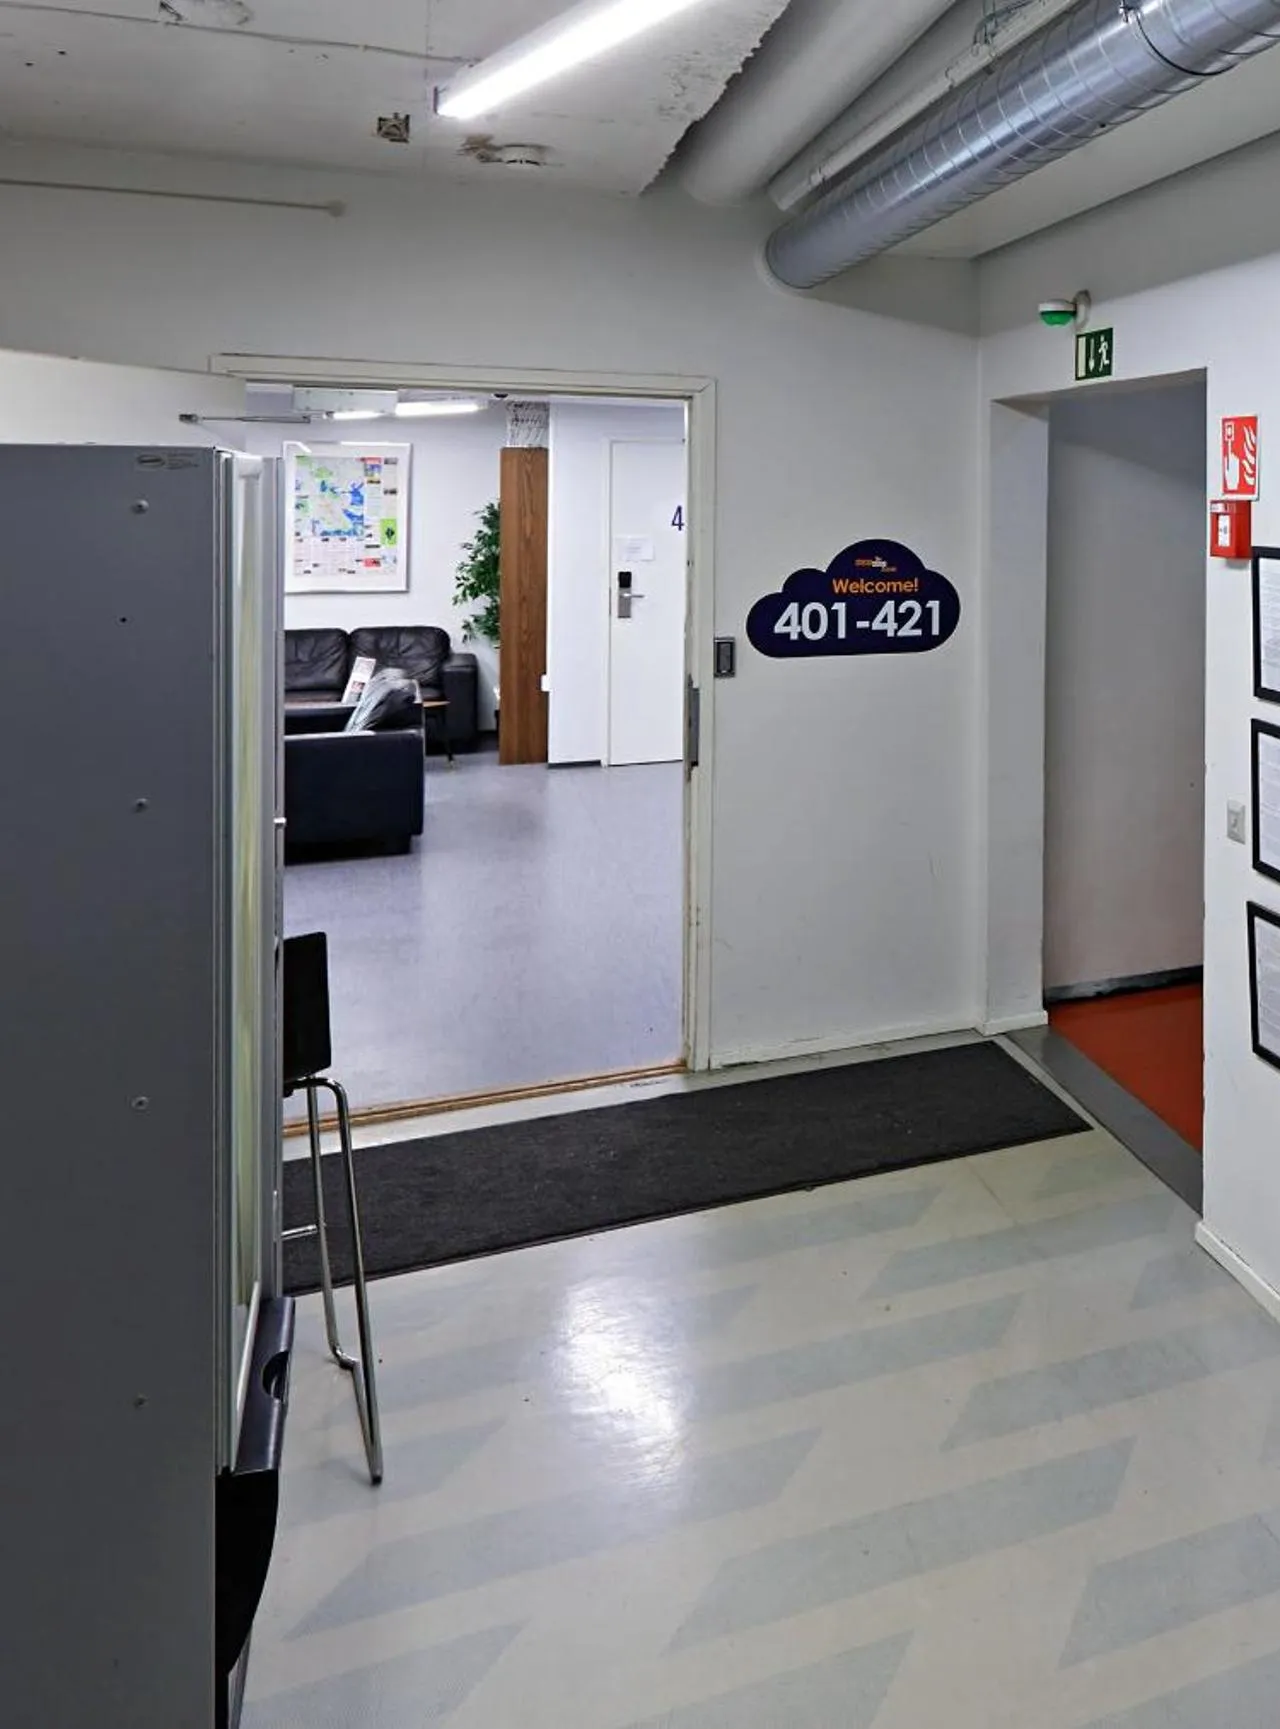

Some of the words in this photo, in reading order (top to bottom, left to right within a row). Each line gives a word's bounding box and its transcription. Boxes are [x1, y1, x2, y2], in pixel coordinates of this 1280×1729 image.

[671, 505, 684, 531] 4
[831, 577, 919, 595] Welcome!
[773, 600, 940, 641] 401-421
